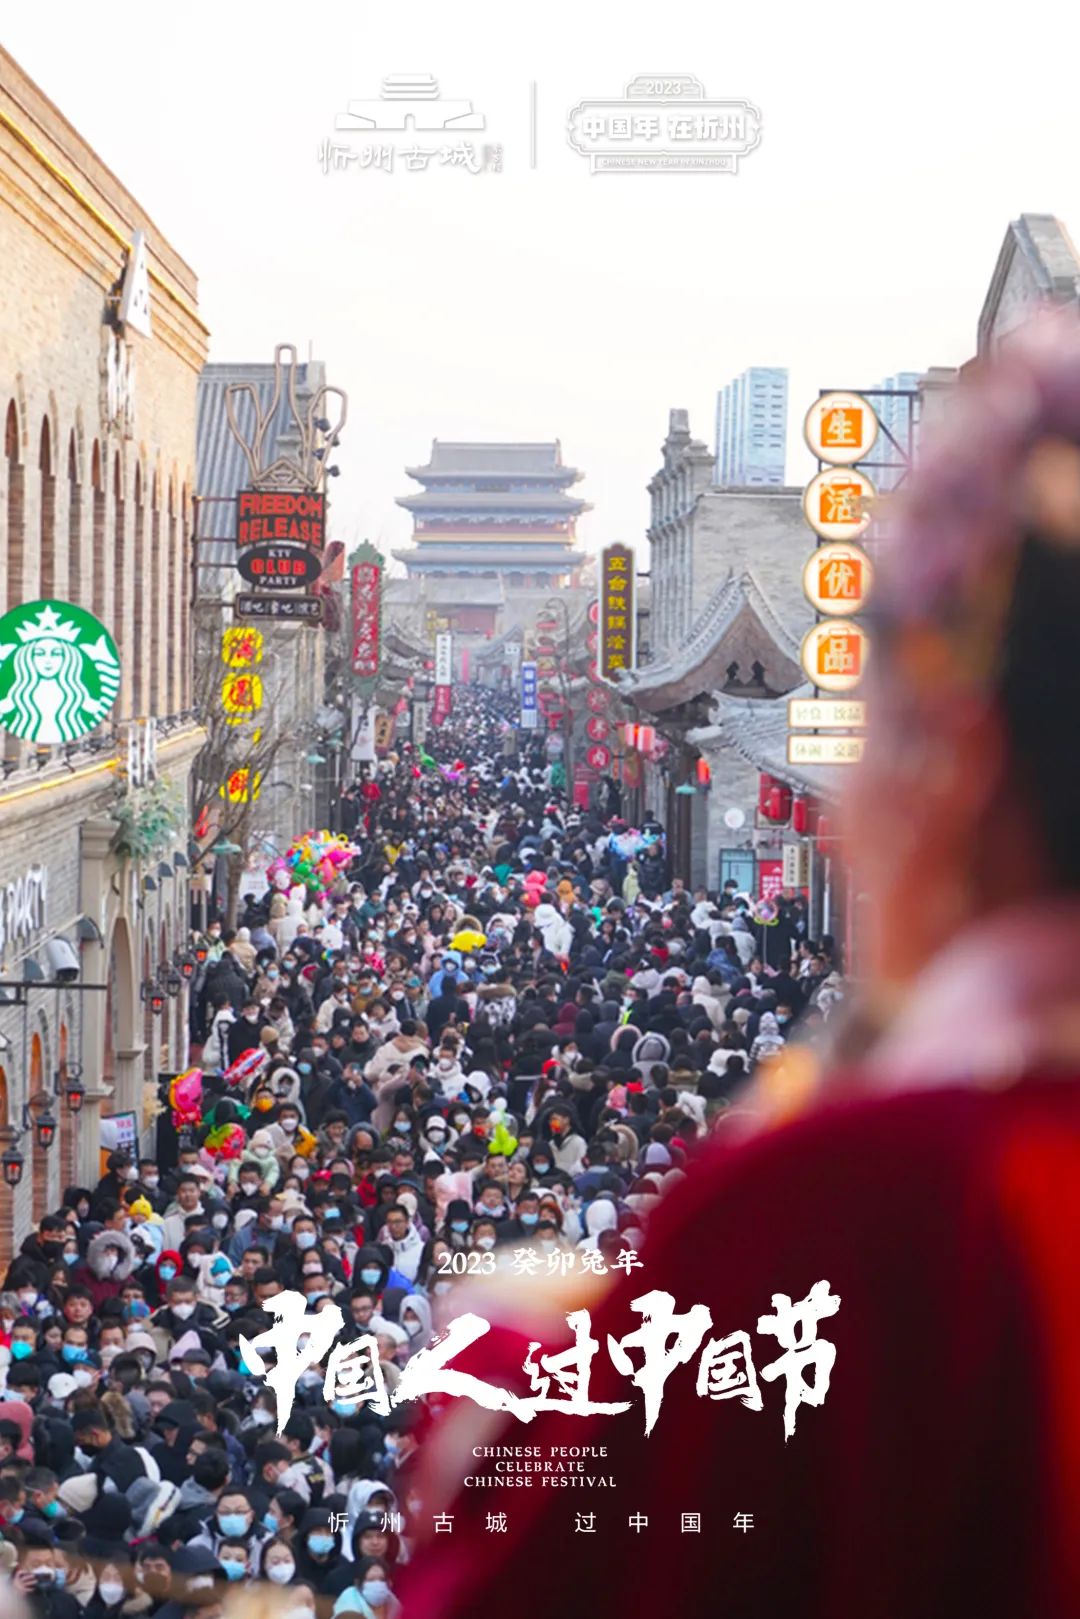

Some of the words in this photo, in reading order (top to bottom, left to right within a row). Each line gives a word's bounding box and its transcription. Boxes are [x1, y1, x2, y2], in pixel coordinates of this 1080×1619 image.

[241, 493, 323, 518] FREEDOM
[239, 517, 322, 545] RELEASE
[822, 410, 858, 673] 生活优品
[251, 558, 306, 575] CLUB
[260, 575, 297, 585] PARTY
